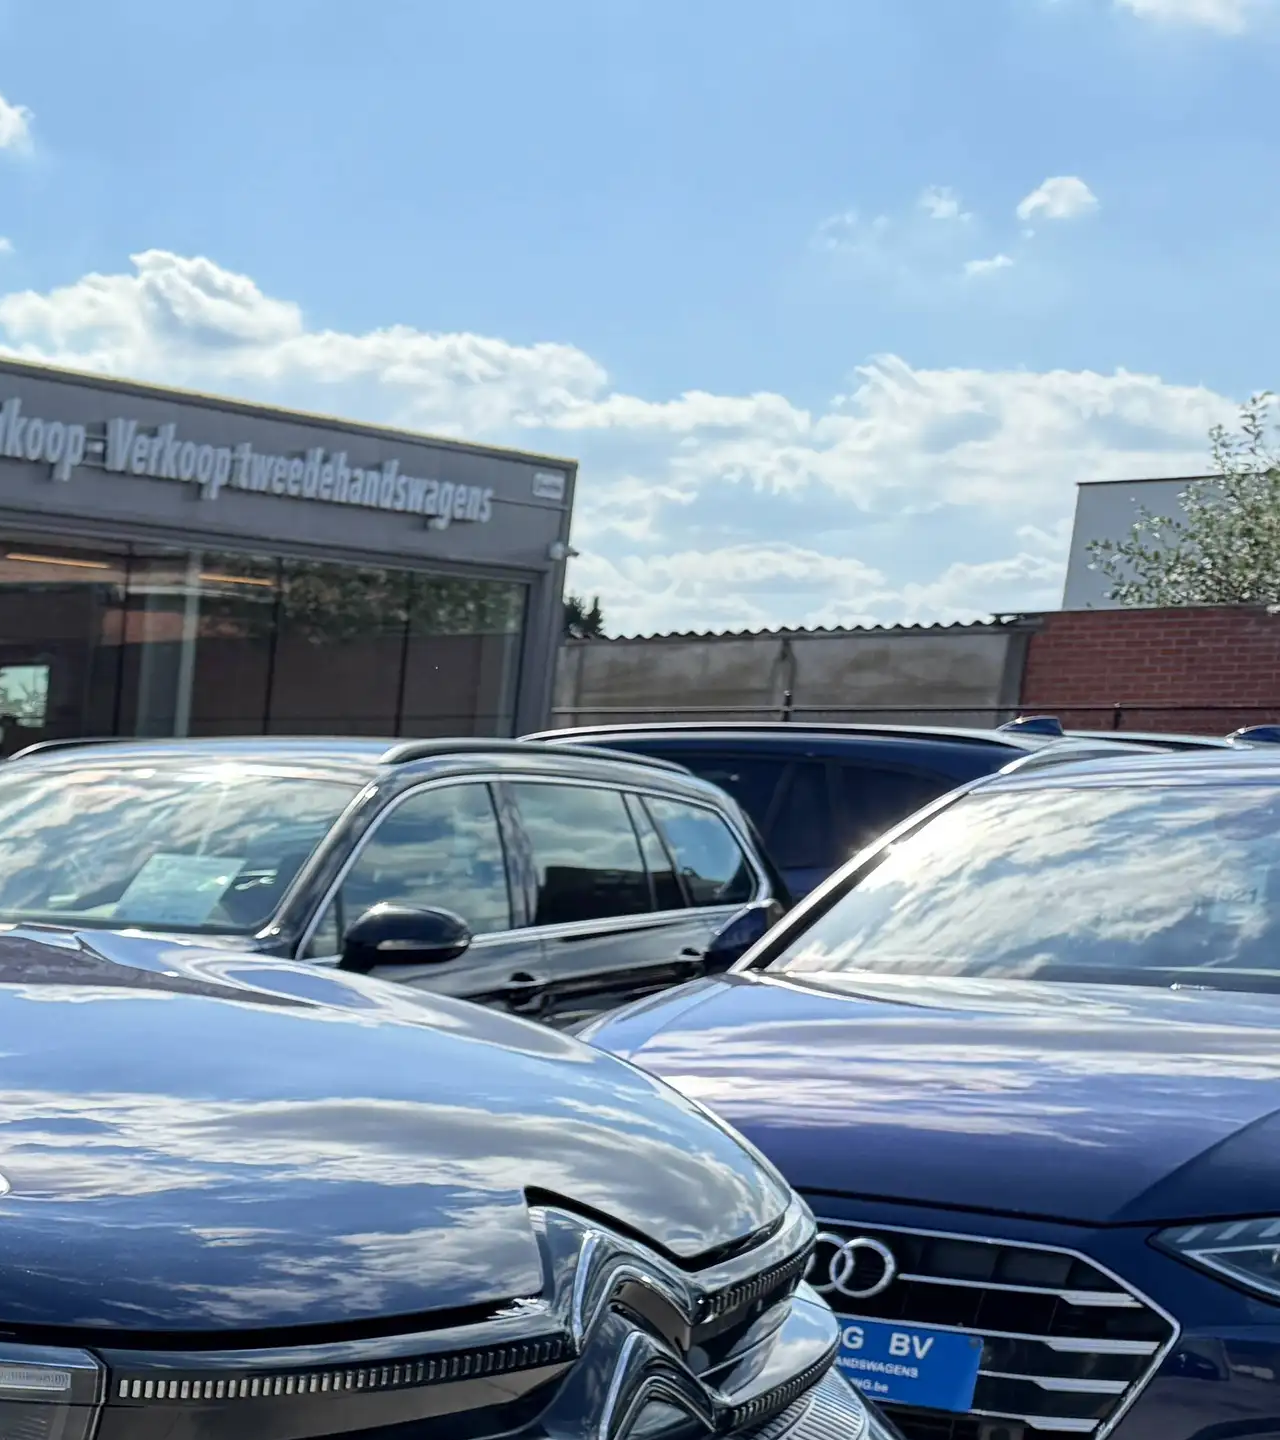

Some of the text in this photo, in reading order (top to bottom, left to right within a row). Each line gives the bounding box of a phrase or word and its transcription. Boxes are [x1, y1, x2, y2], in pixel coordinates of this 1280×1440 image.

[105, 416, 231, 500] Verkoop
[234, 442, 495, 530] tweedehandswagens
[842, 1326, 934, 1359] G BV
